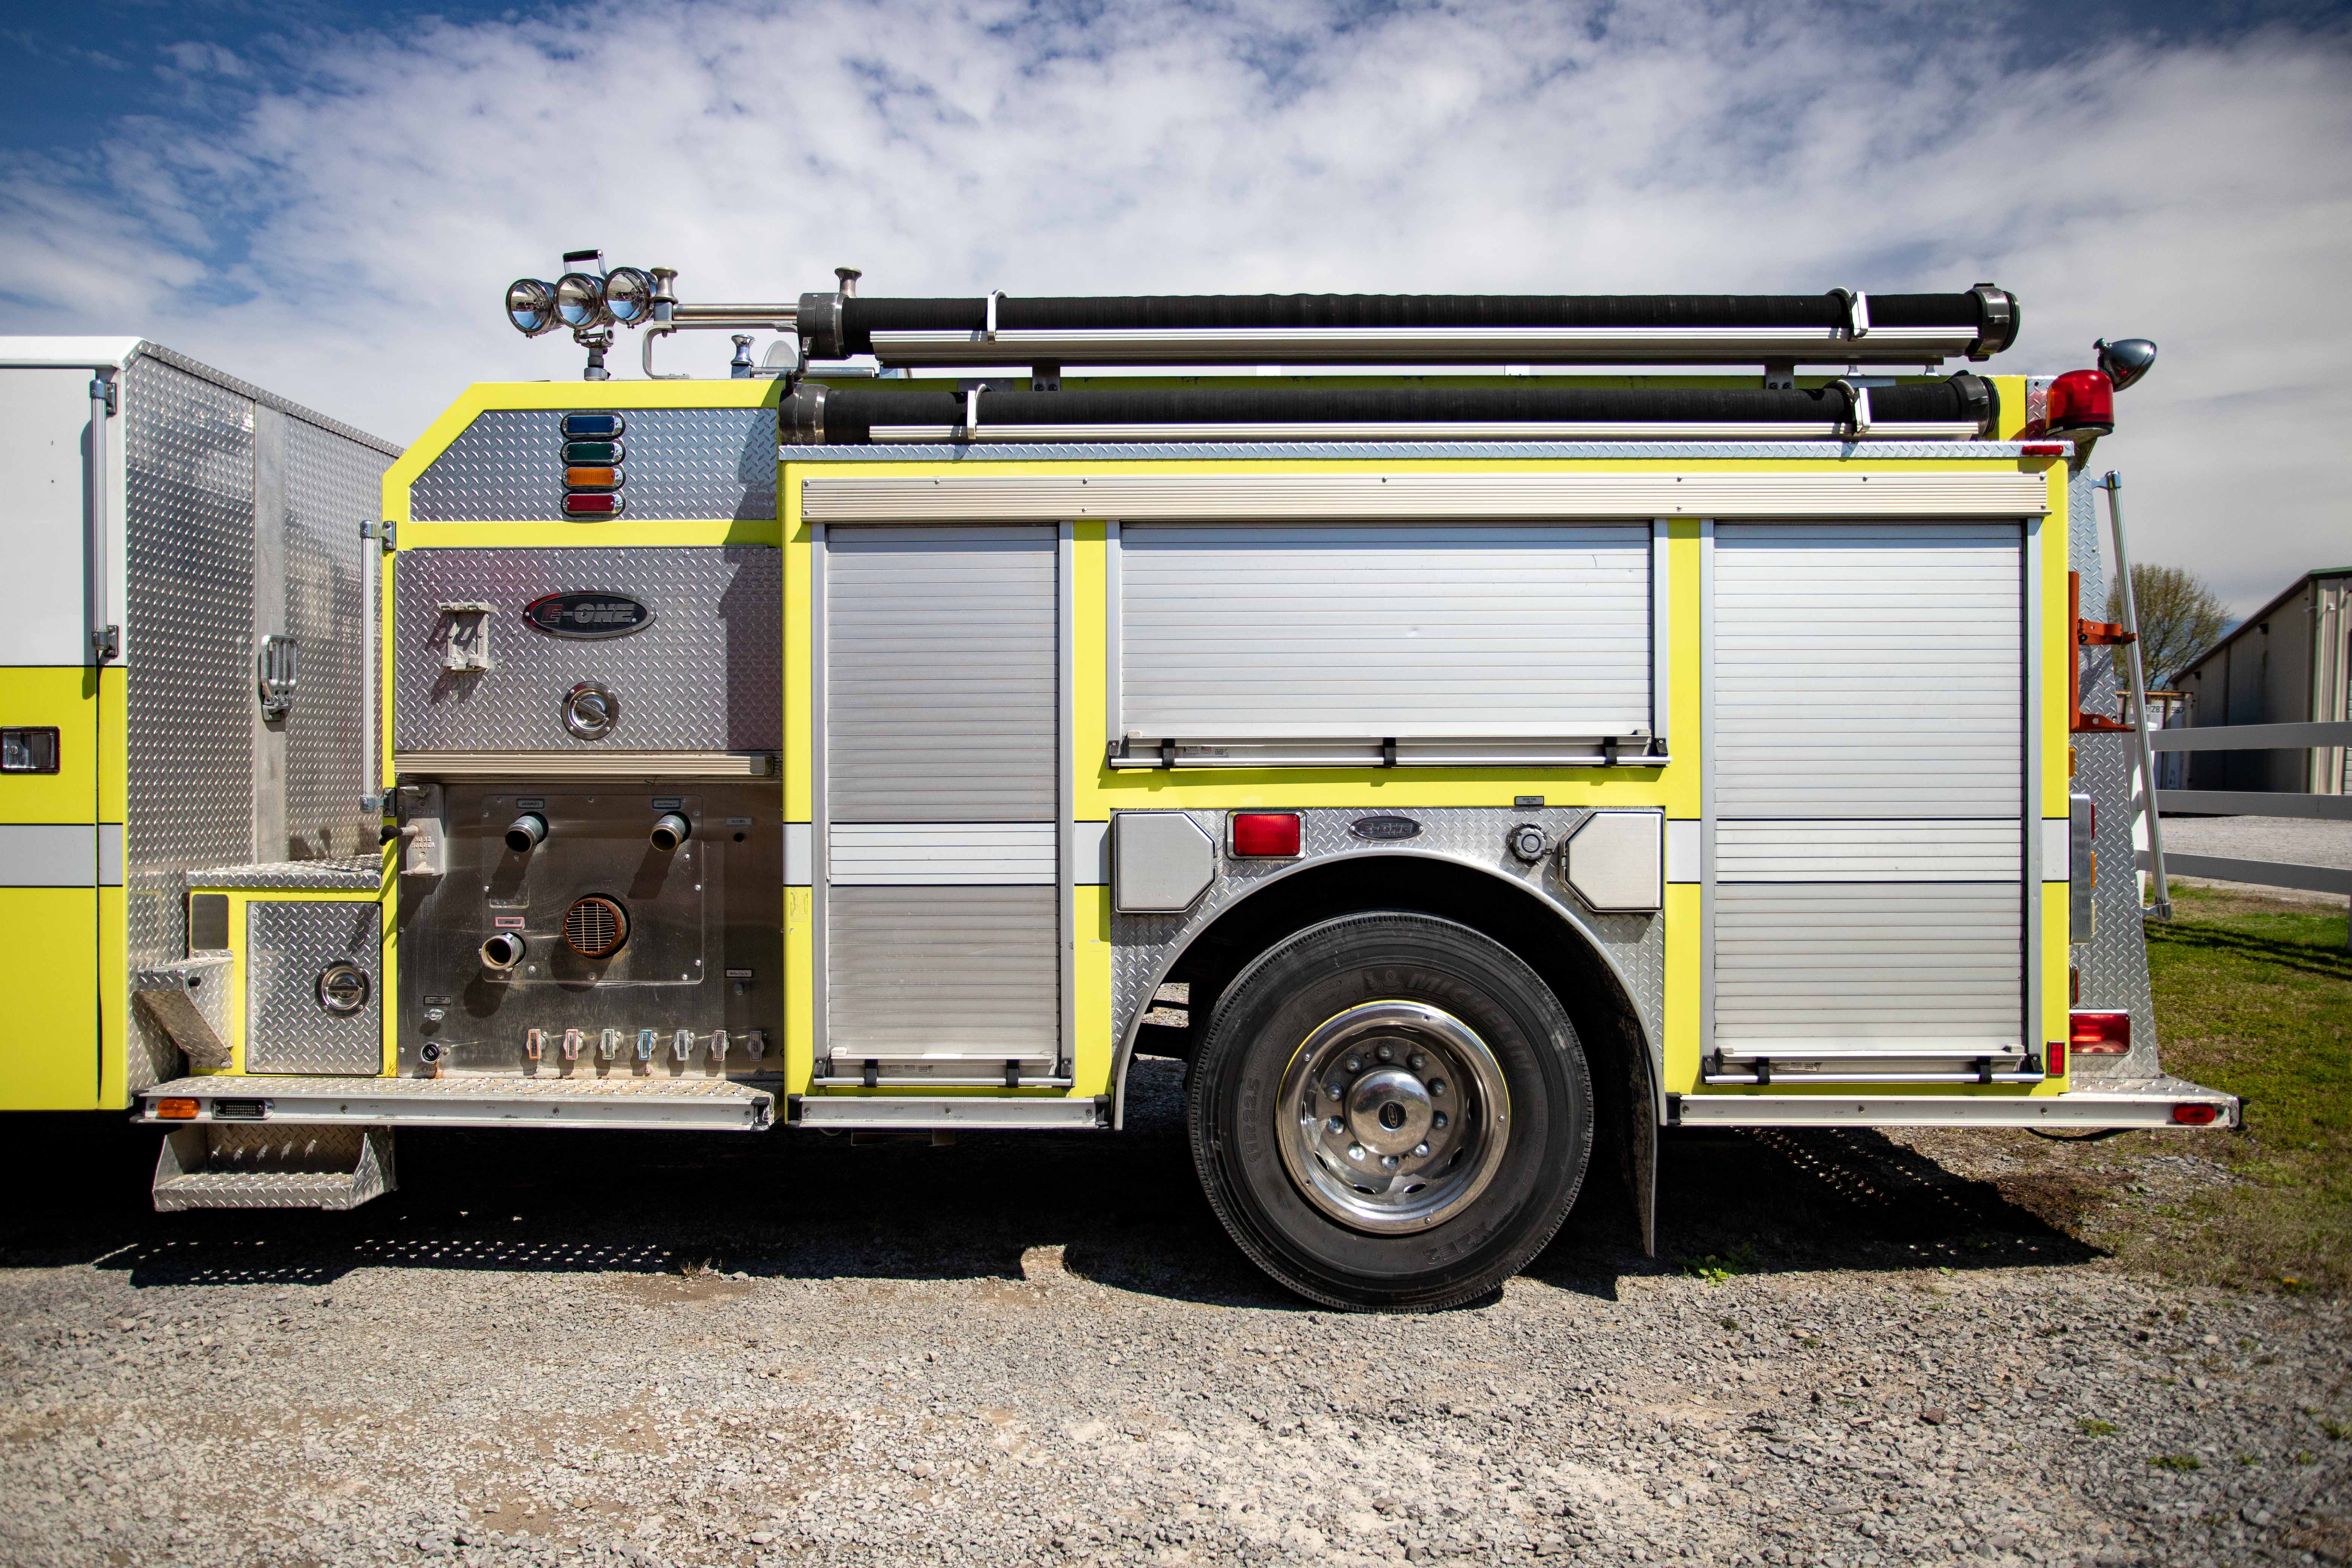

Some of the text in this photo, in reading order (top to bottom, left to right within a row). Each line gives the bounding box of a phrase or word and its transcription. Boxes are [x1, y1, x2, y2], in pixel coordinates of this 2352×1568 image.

[541, 603, 634, 623] E-ONE
[1361, 823, 1413, 834] E-ONE
[1408, 972, 1533, 1069] MICHELIN
[1243, 1077, 1261, 1162] 11R22.5
